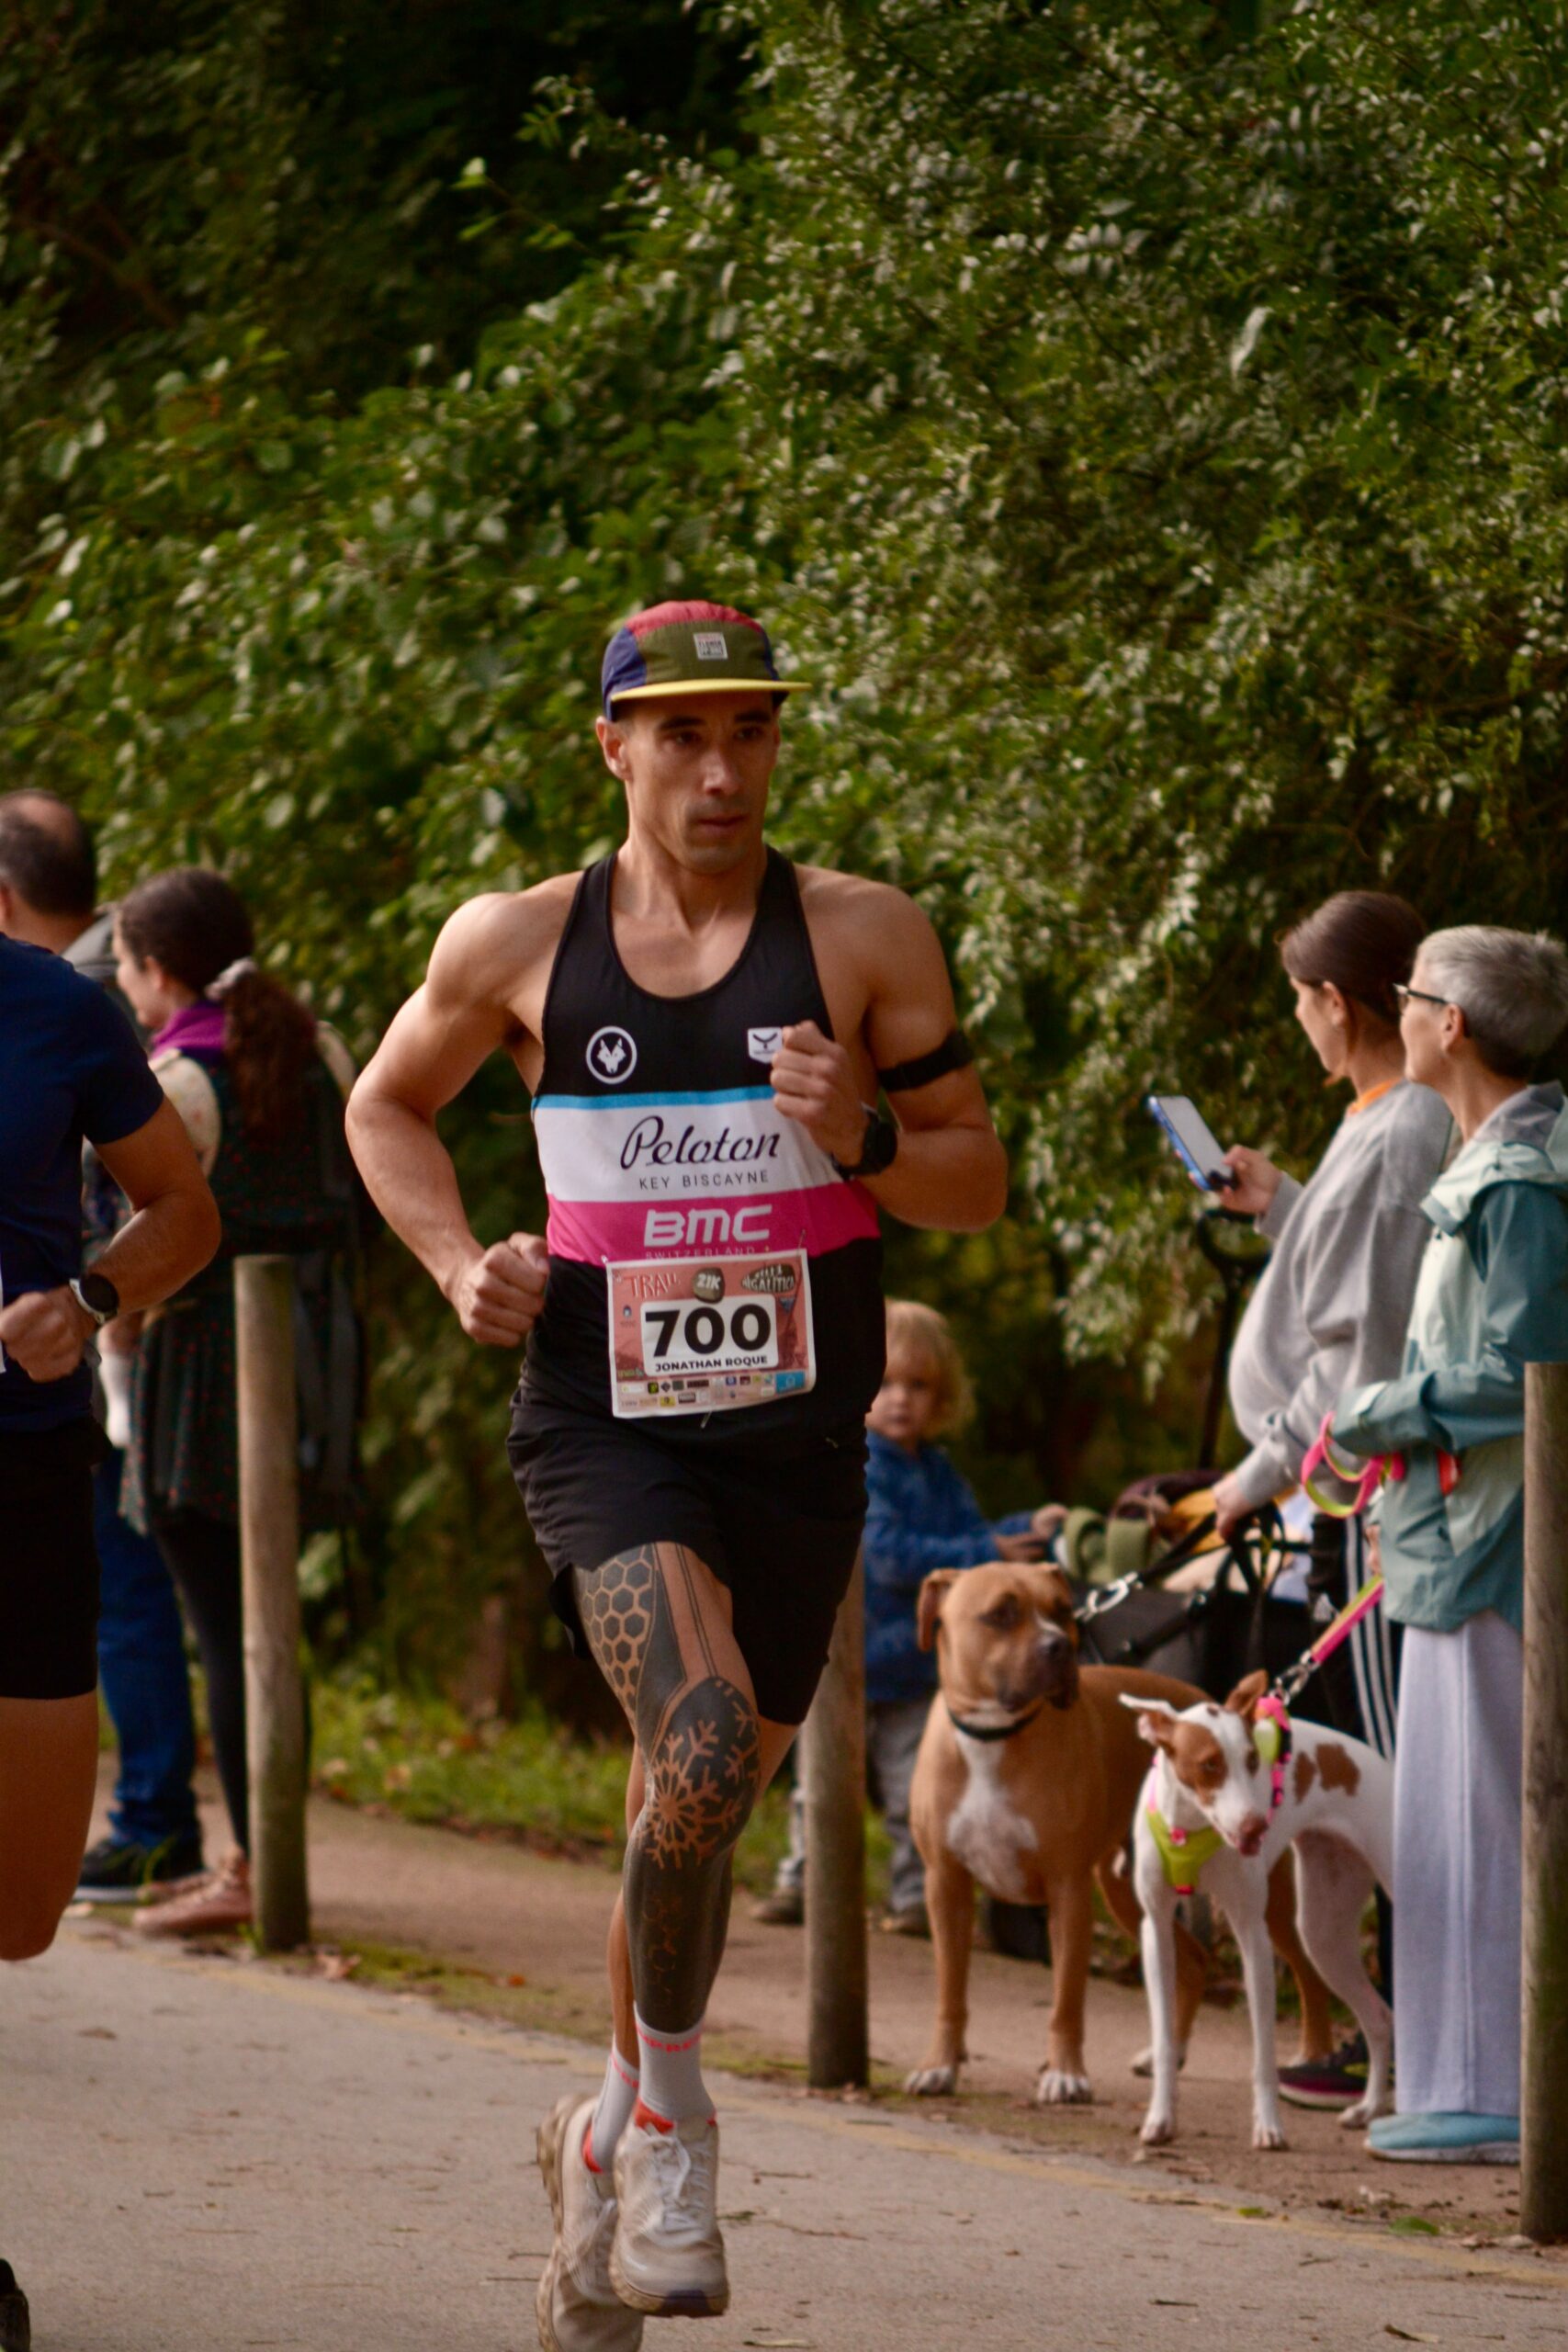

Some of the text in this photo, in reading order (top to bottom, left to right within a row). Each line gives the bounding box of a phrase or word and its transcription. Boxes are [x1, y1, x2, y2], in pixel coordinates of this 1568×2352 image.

[620, 1115, 781, 1170] Peloton
[639, 1170, 770, 1191] KEY BISCAYNE
[644, 1204, 773, 1247] BMC
[695, 1273, 721, 1291] 21K
[645, 1304, 772, 1358] 700
[655, 1355, 768, 1373] JONATHAN ROQUE
